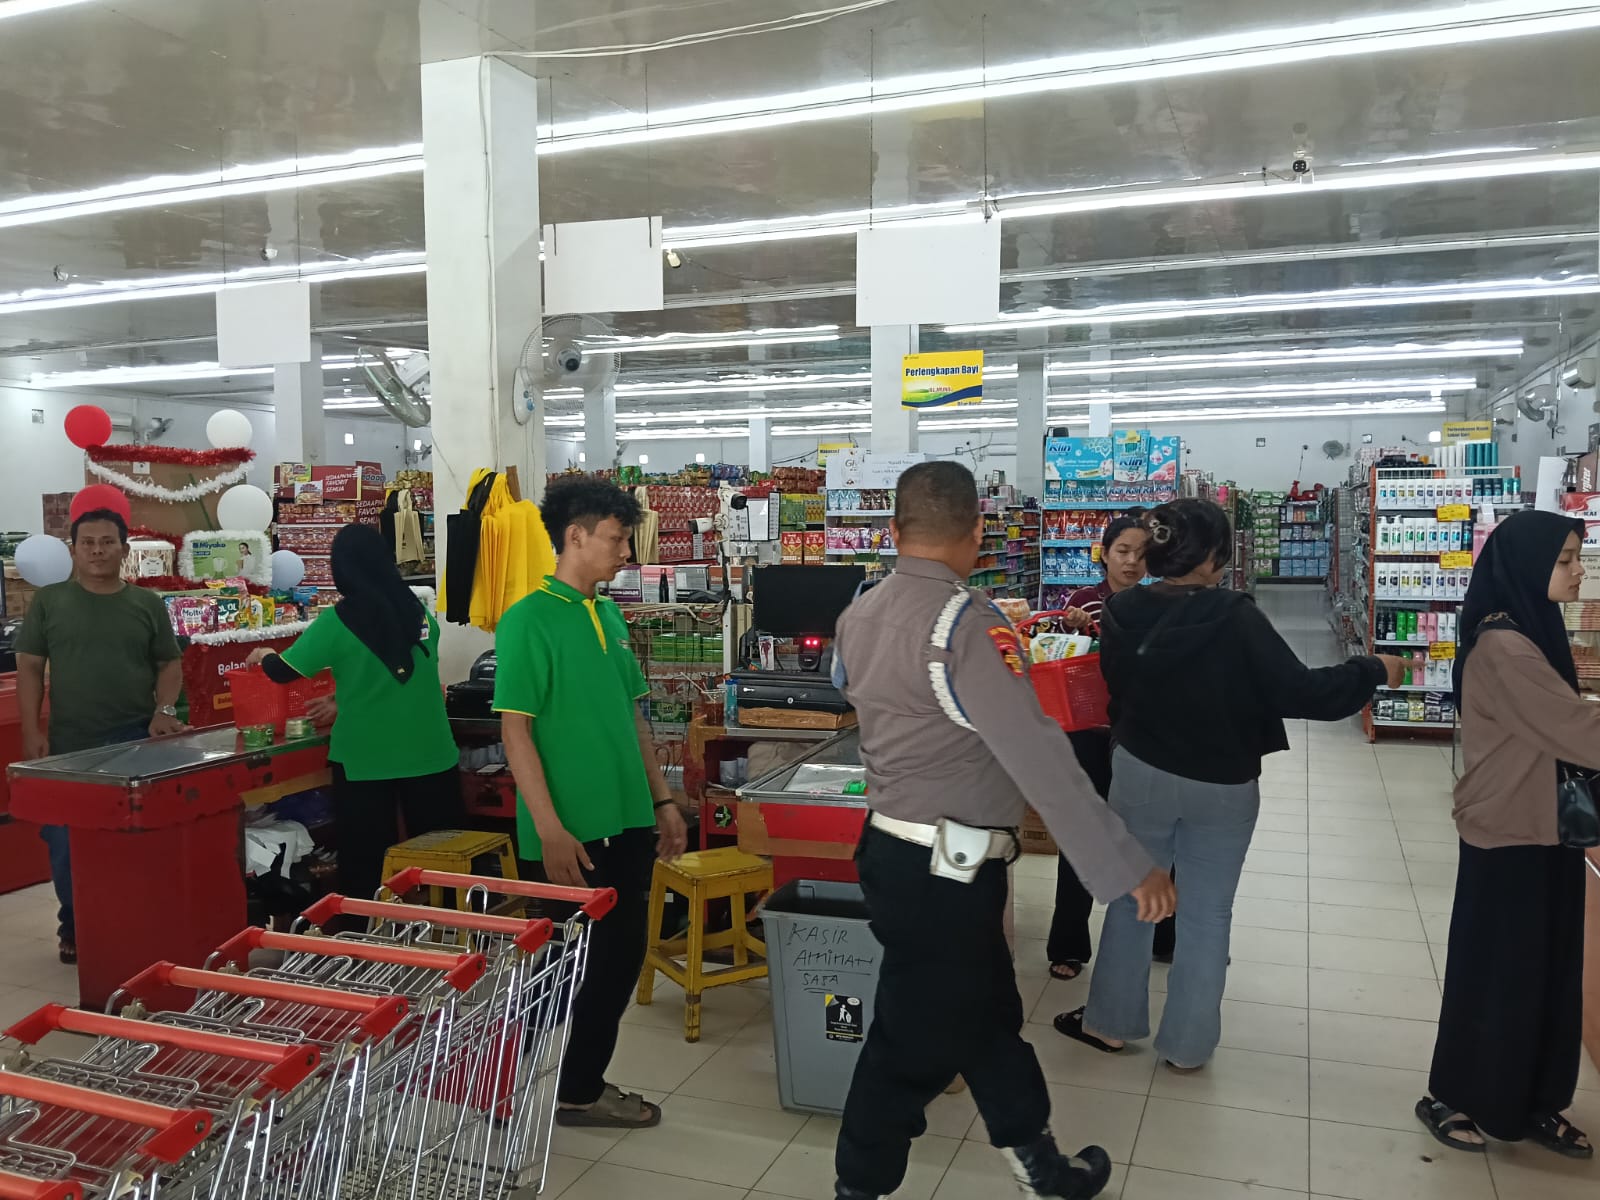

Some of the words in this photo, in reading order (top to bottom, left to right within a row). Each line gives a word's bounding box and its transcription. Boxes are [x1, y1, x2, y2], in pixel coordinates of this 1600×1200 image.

[905, 367, 960, 377] Perlengkapan
[961, 365, 979, 374] Bayi
[200, 541, 226, 550] Miyako
